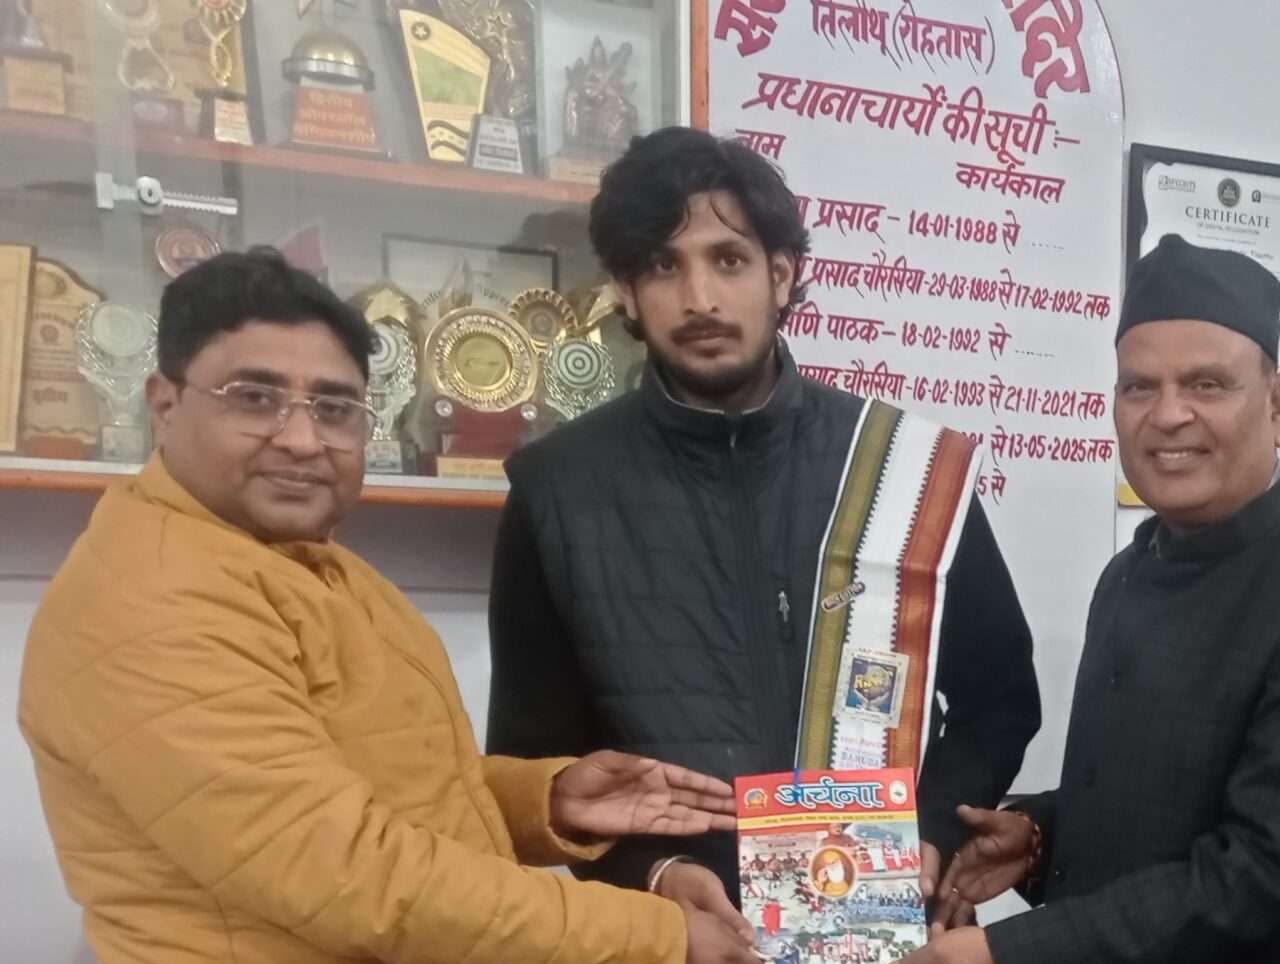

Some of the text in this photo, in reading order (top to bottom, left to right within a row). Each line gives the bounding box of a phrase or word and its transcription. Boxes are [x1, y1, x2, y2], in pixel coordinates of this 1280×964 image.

[955, 161, 1066, 203] कार्यकाल
[813, 198, 887, 244] प्रसाद
[1002, 209, 1021, 254] से
[1185, 206, 1271, 229] CERTIFICATE
[800, 257, 865, 298] प्रसाद
[988, 322, 1012, 361] से
